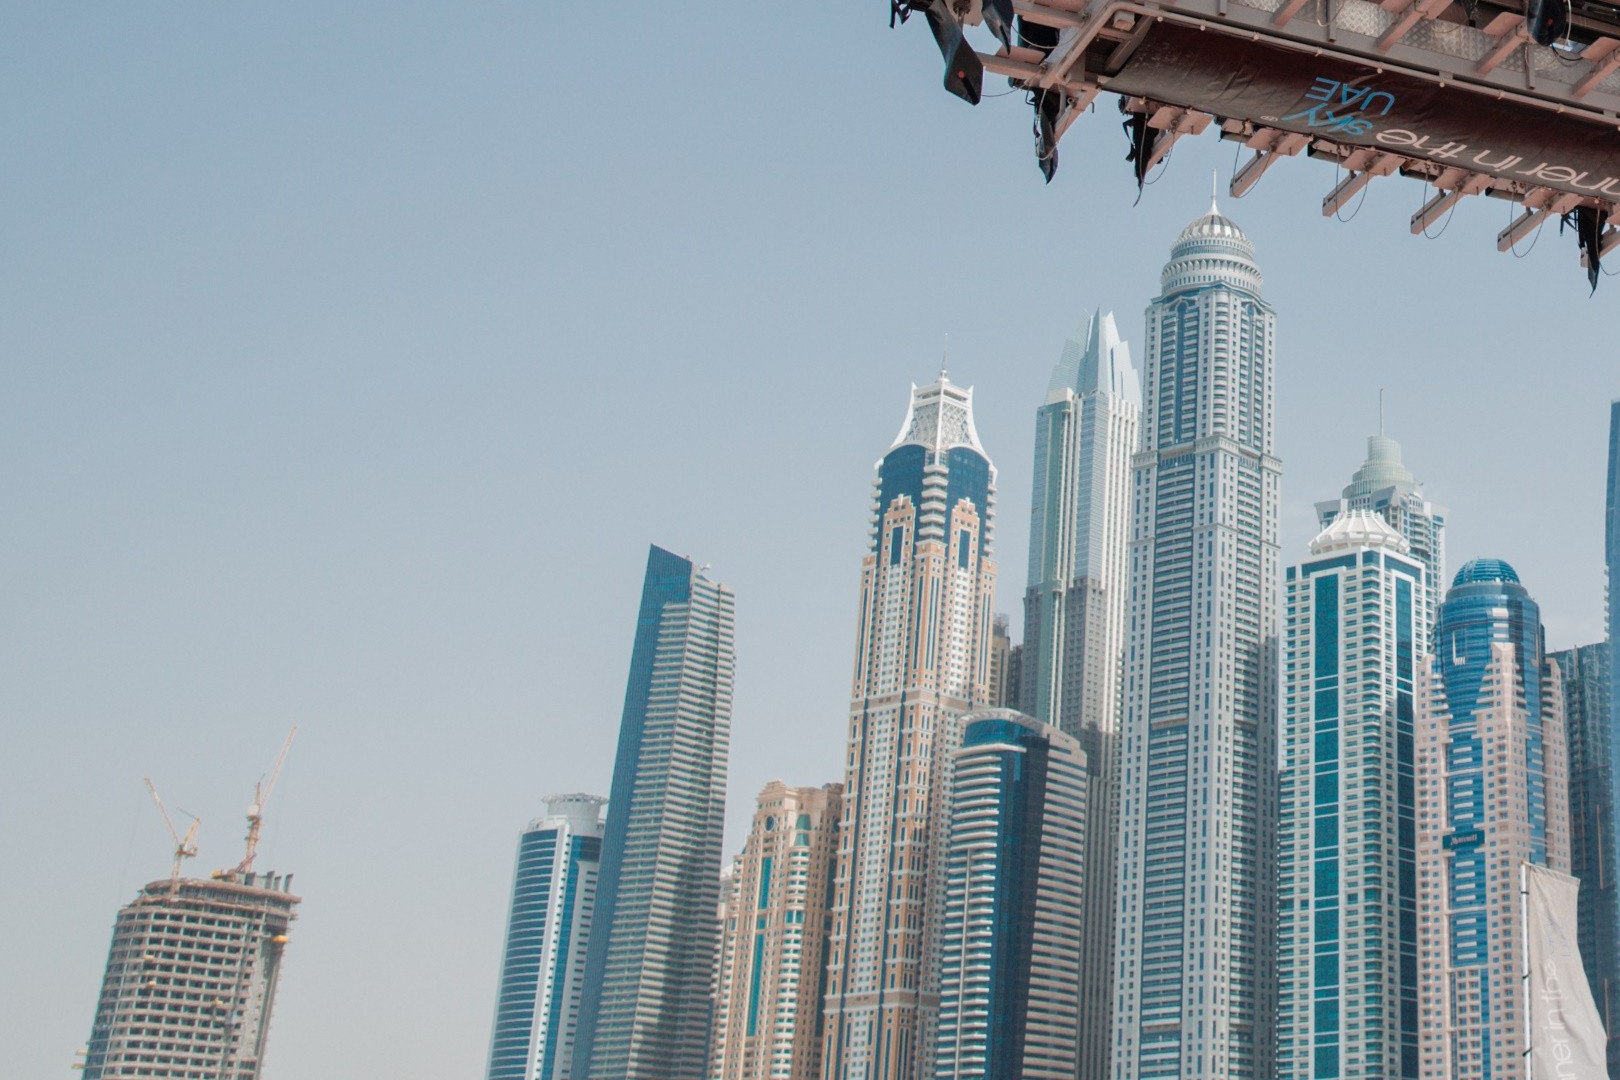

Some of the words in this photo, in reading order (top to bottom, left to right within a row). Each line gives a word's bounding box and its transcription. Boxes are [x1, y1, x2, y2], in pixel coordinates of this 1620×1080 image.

[1305, 76, 1396, 116] UAE
[1375, 128, 1468, 159] the
[1472, 149, 1523, 171] in
[1541, 960, 1562, 1002] the
[1540, 1009, 1564, 1030] in
